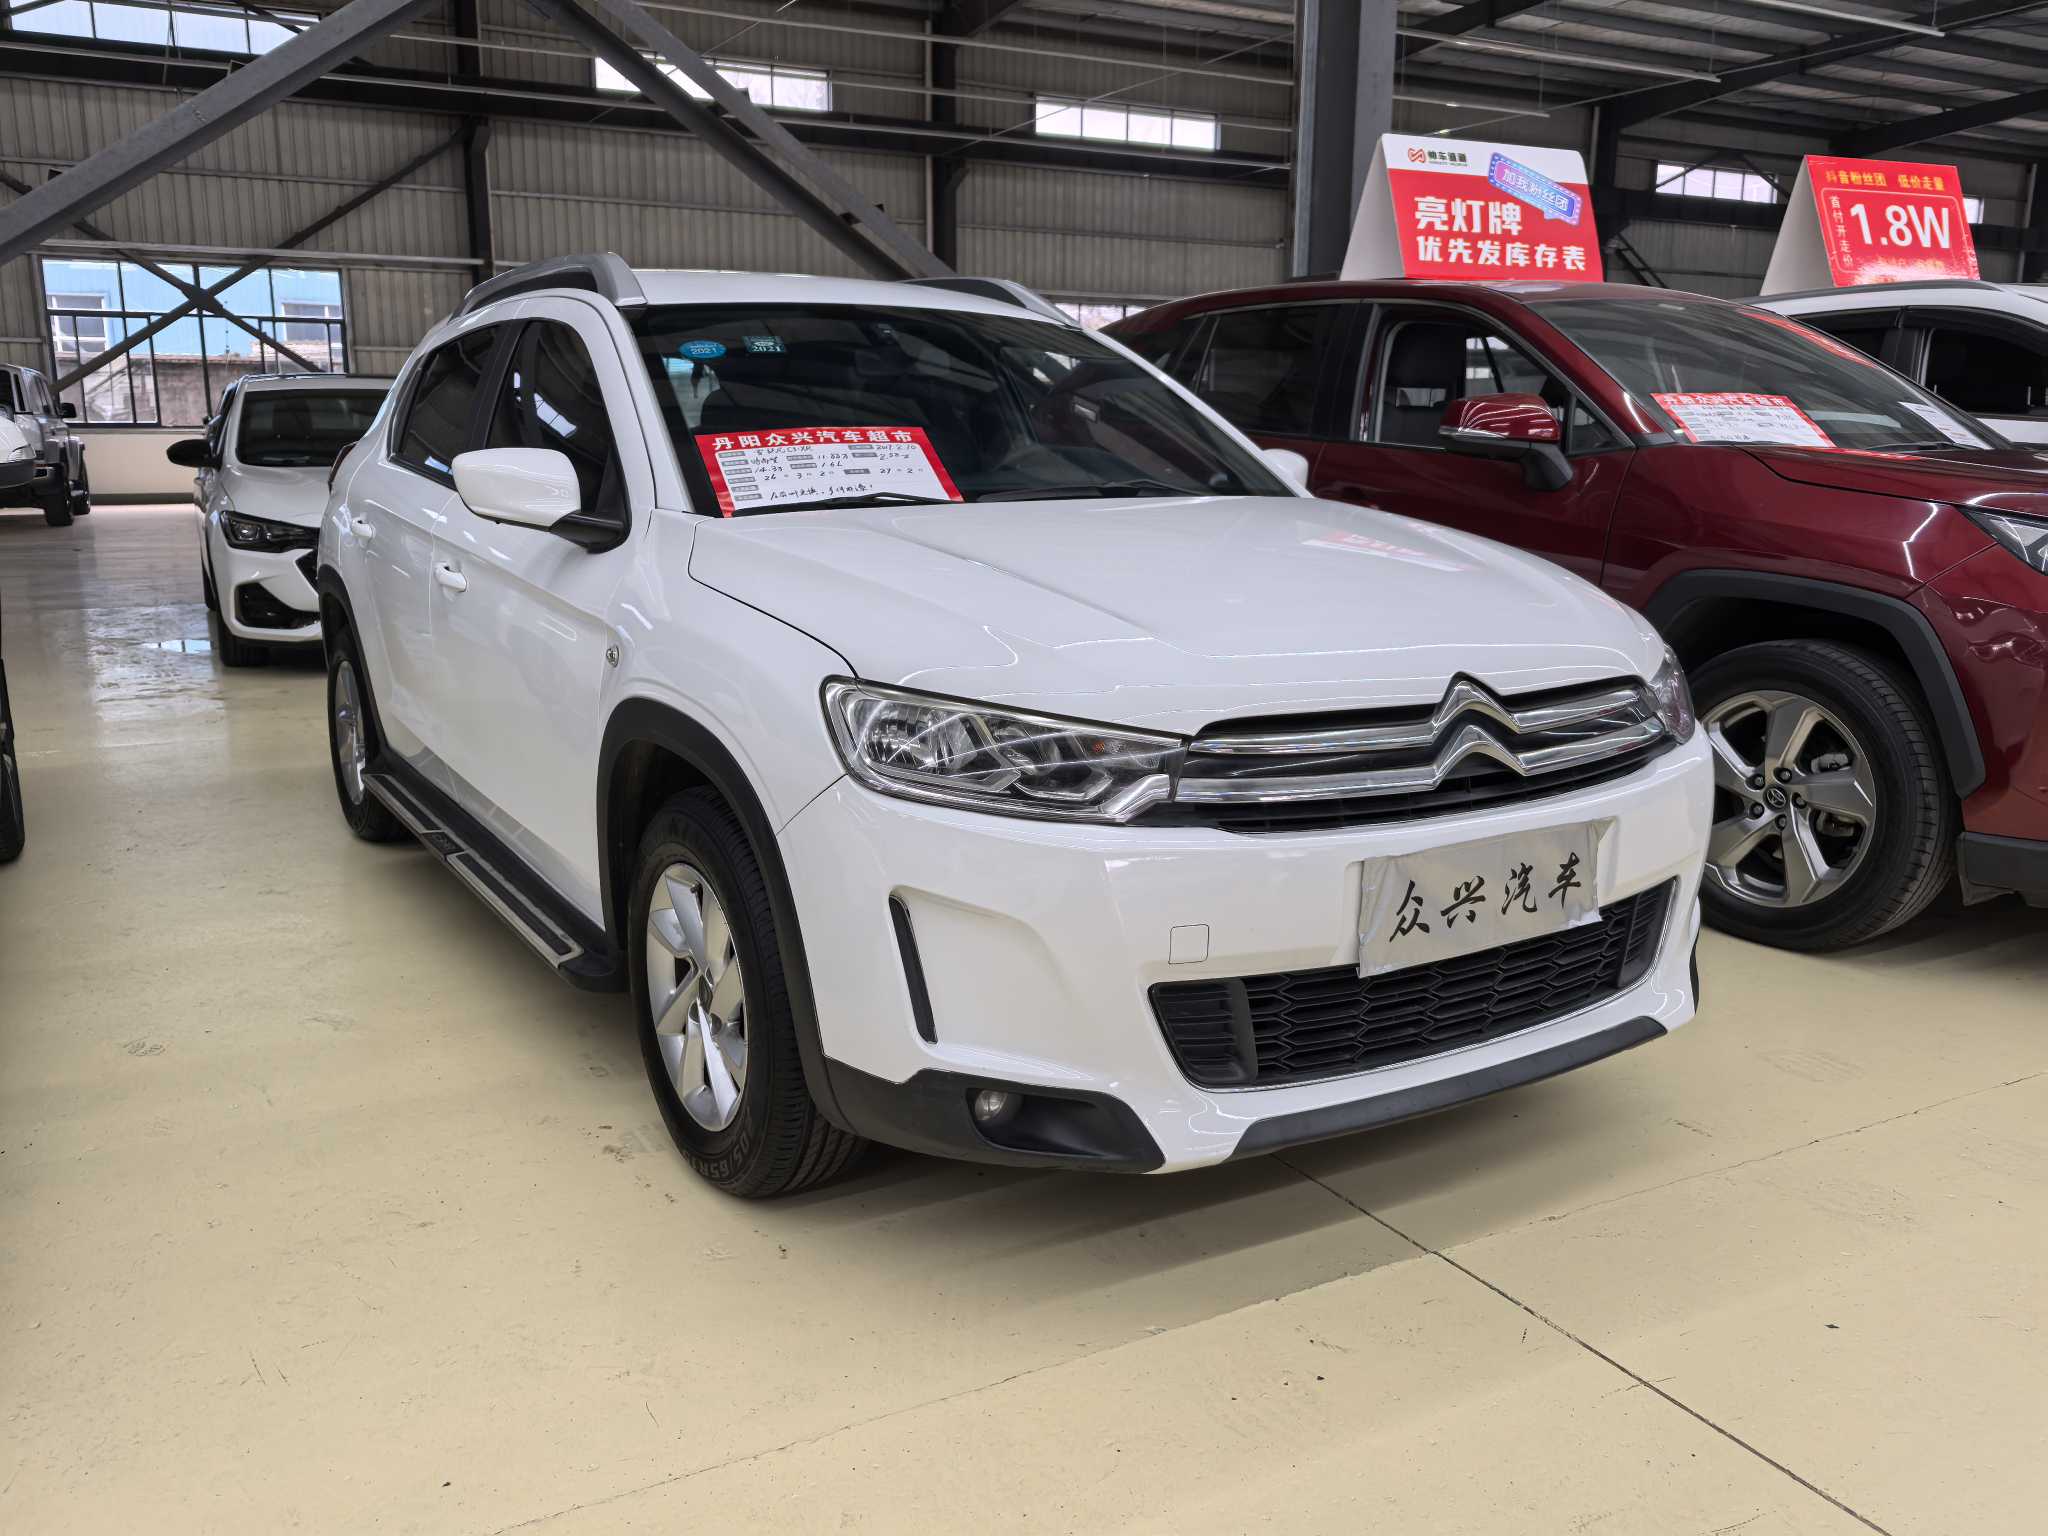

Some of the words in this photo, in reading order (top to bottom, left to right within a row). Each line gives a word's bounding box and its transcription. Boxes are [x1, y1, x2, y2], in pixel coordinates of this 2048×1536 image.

[1825, 170, 1887, 187] 抖音粉丝团
[1897, 175, 1945, 191] 低价走量
[1413, 196, 1523, 236] 亮灯牌
[1850, 203, 1950, 249] 1.8W
[1416, 235, 1586, 271] 优先发库存表
[712, 430, 912, 450] 丹阳众兴汽车超市
[1389, 852, 1582, 943] 众兴汽车
